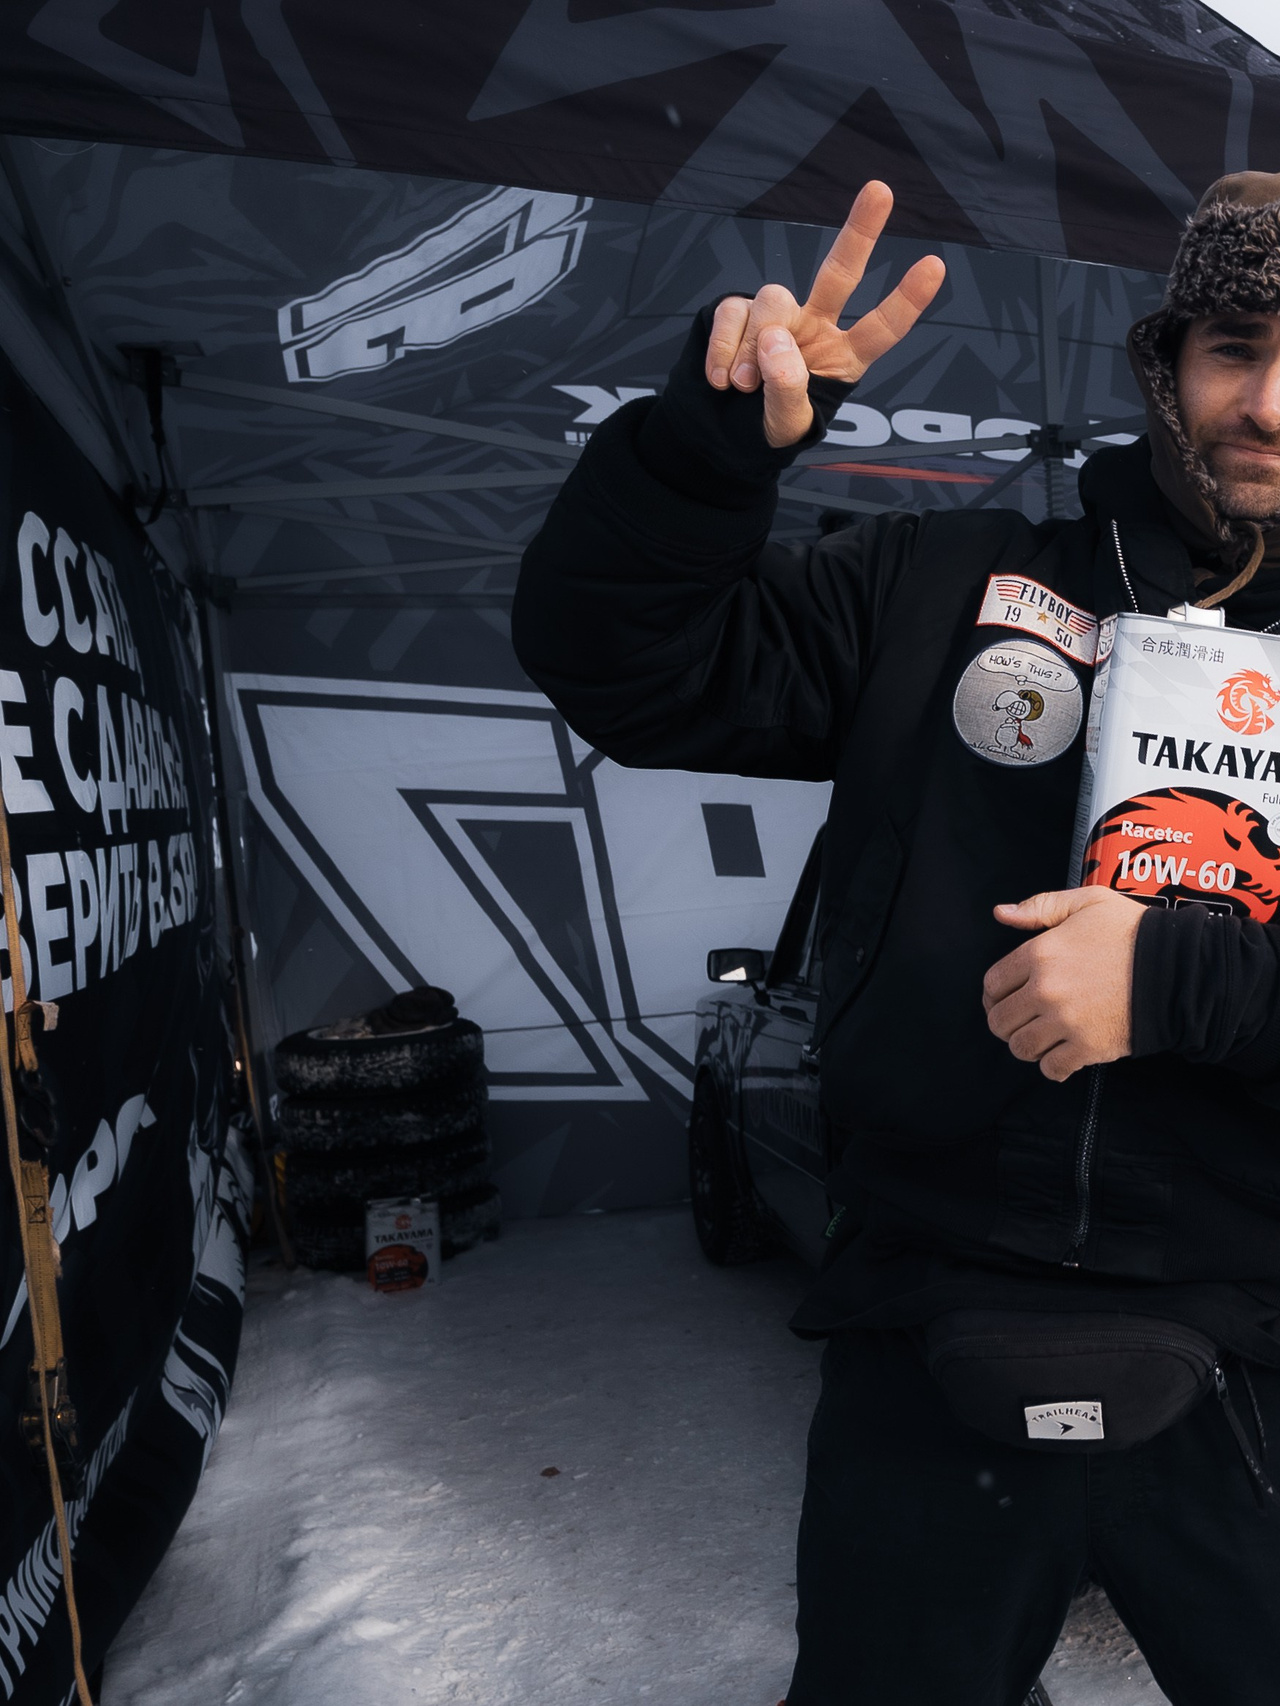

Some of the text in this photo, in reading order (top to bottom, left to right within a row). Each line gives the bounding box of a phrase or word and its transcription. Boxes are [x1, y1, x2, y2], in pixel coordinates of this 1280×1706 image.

[1004, 605, 1022, 622] 19
[1019, 582, 1073, 625] FLYBOY
[1055, 629, 1073, 649] 50
[988, 654, 1022, 669] HOW'S
[1120, 820, 1194, 845] Racetec
[1117, 849, 1237, 892] 10W-60
[374, 1228, 434, 1244] TAKAYAMA
